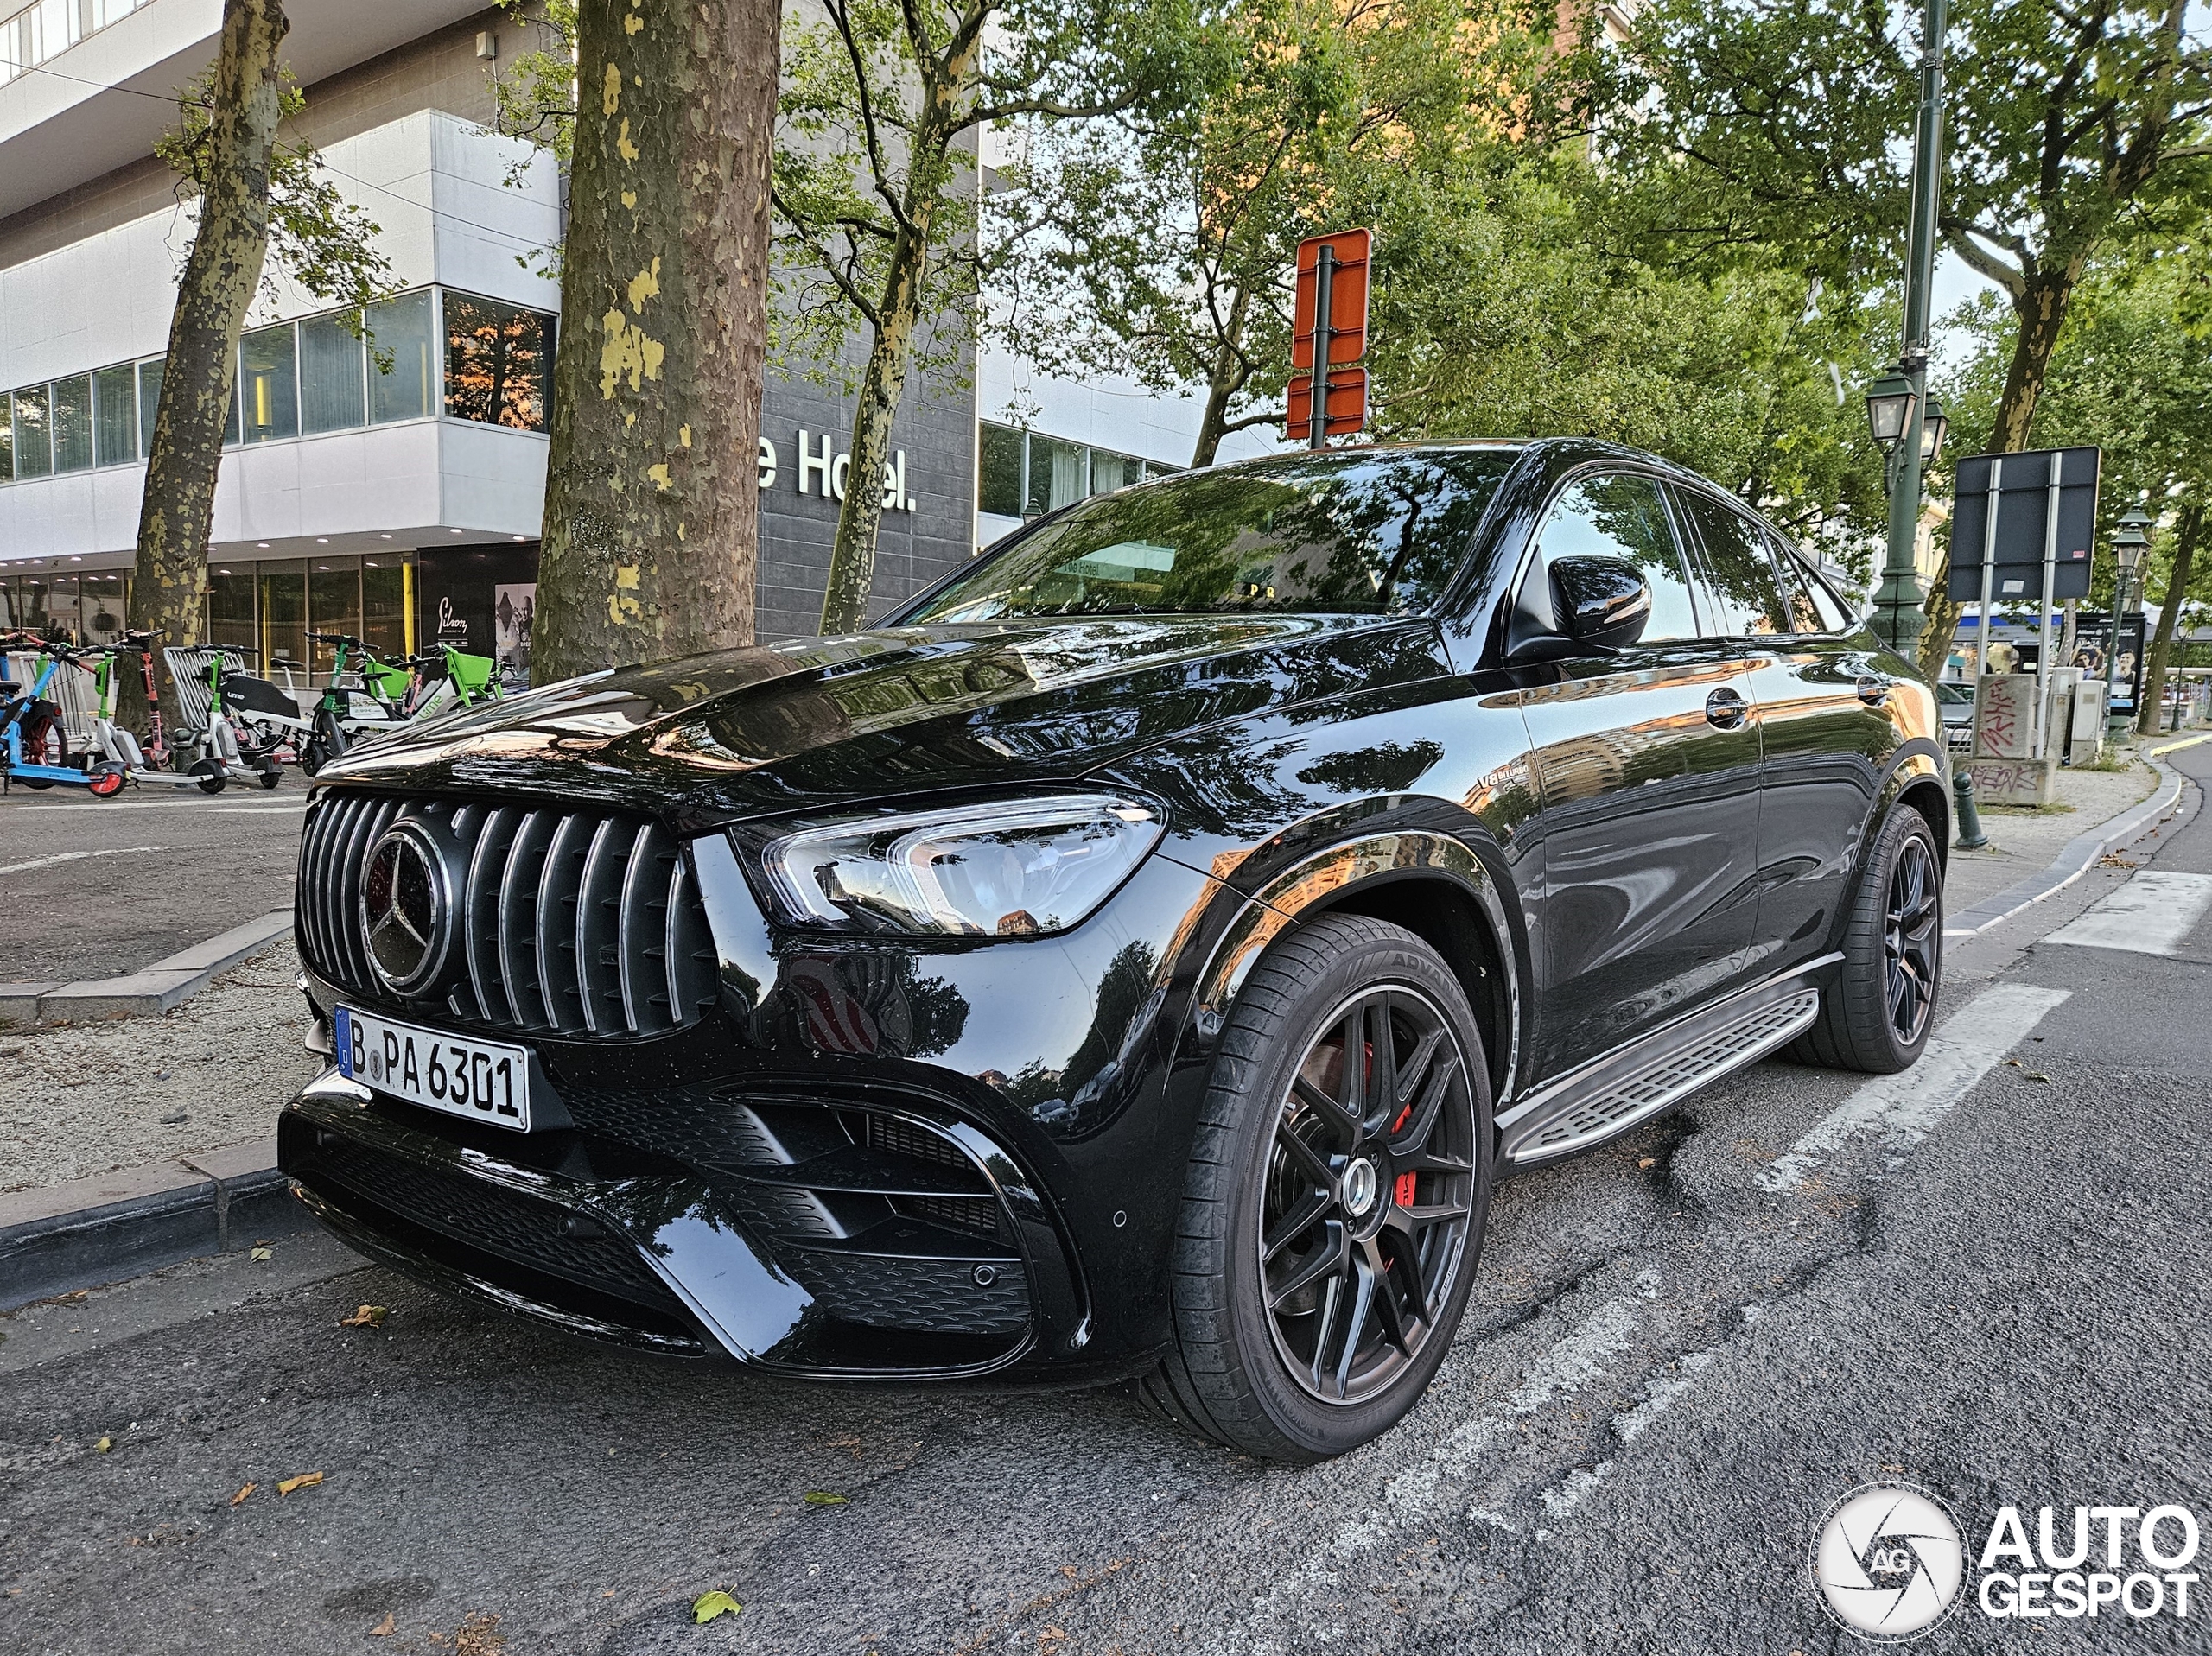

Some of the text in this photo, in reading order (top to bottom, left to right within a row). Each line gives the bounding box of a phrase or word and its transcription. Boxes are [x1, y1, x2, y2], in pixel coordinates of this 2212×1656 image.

[798, 429, 916, 511] Hoel.
[418, 695, 443, 720] Lime
[1478, 773, 1498, 789] V8
[1497, 765, 1529, 779] BITURBO
[1391, 953, 1454, 998] ADVAN
[350, 1019, 520, 1119] B PA 6301
